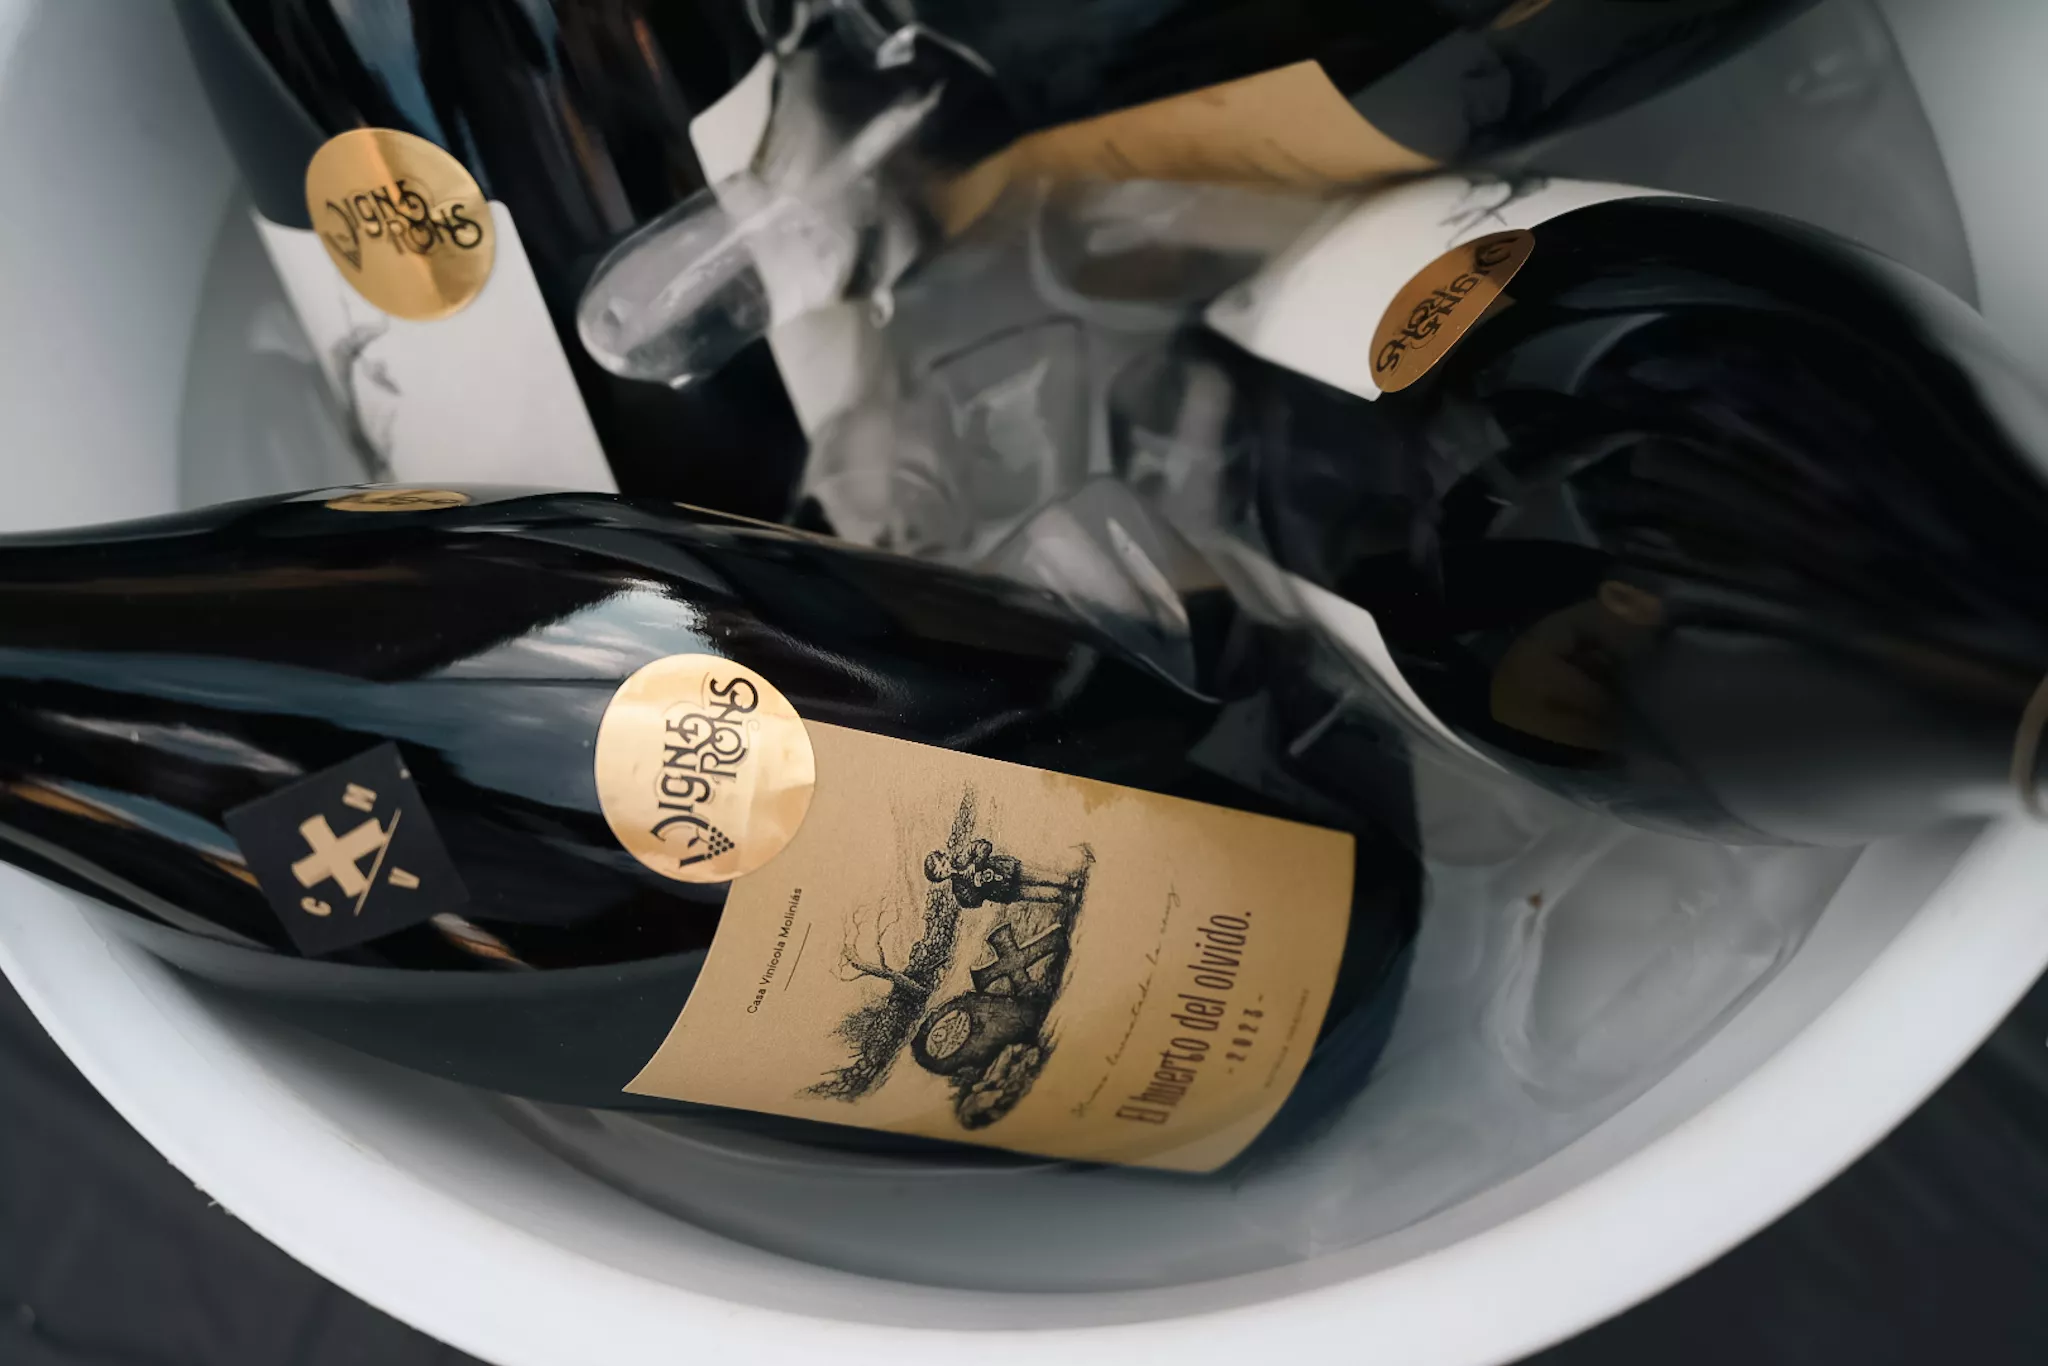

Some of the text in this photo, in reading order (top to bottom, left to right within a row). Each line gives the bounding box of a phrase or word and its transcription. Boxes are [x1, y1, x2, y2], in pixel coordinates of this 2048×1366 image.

[747, 988, 767, 1014] Casa
[778, 887, 803, 938] Moliniás
[1115, 911, 1252, 1125] El huerto del olvido.
